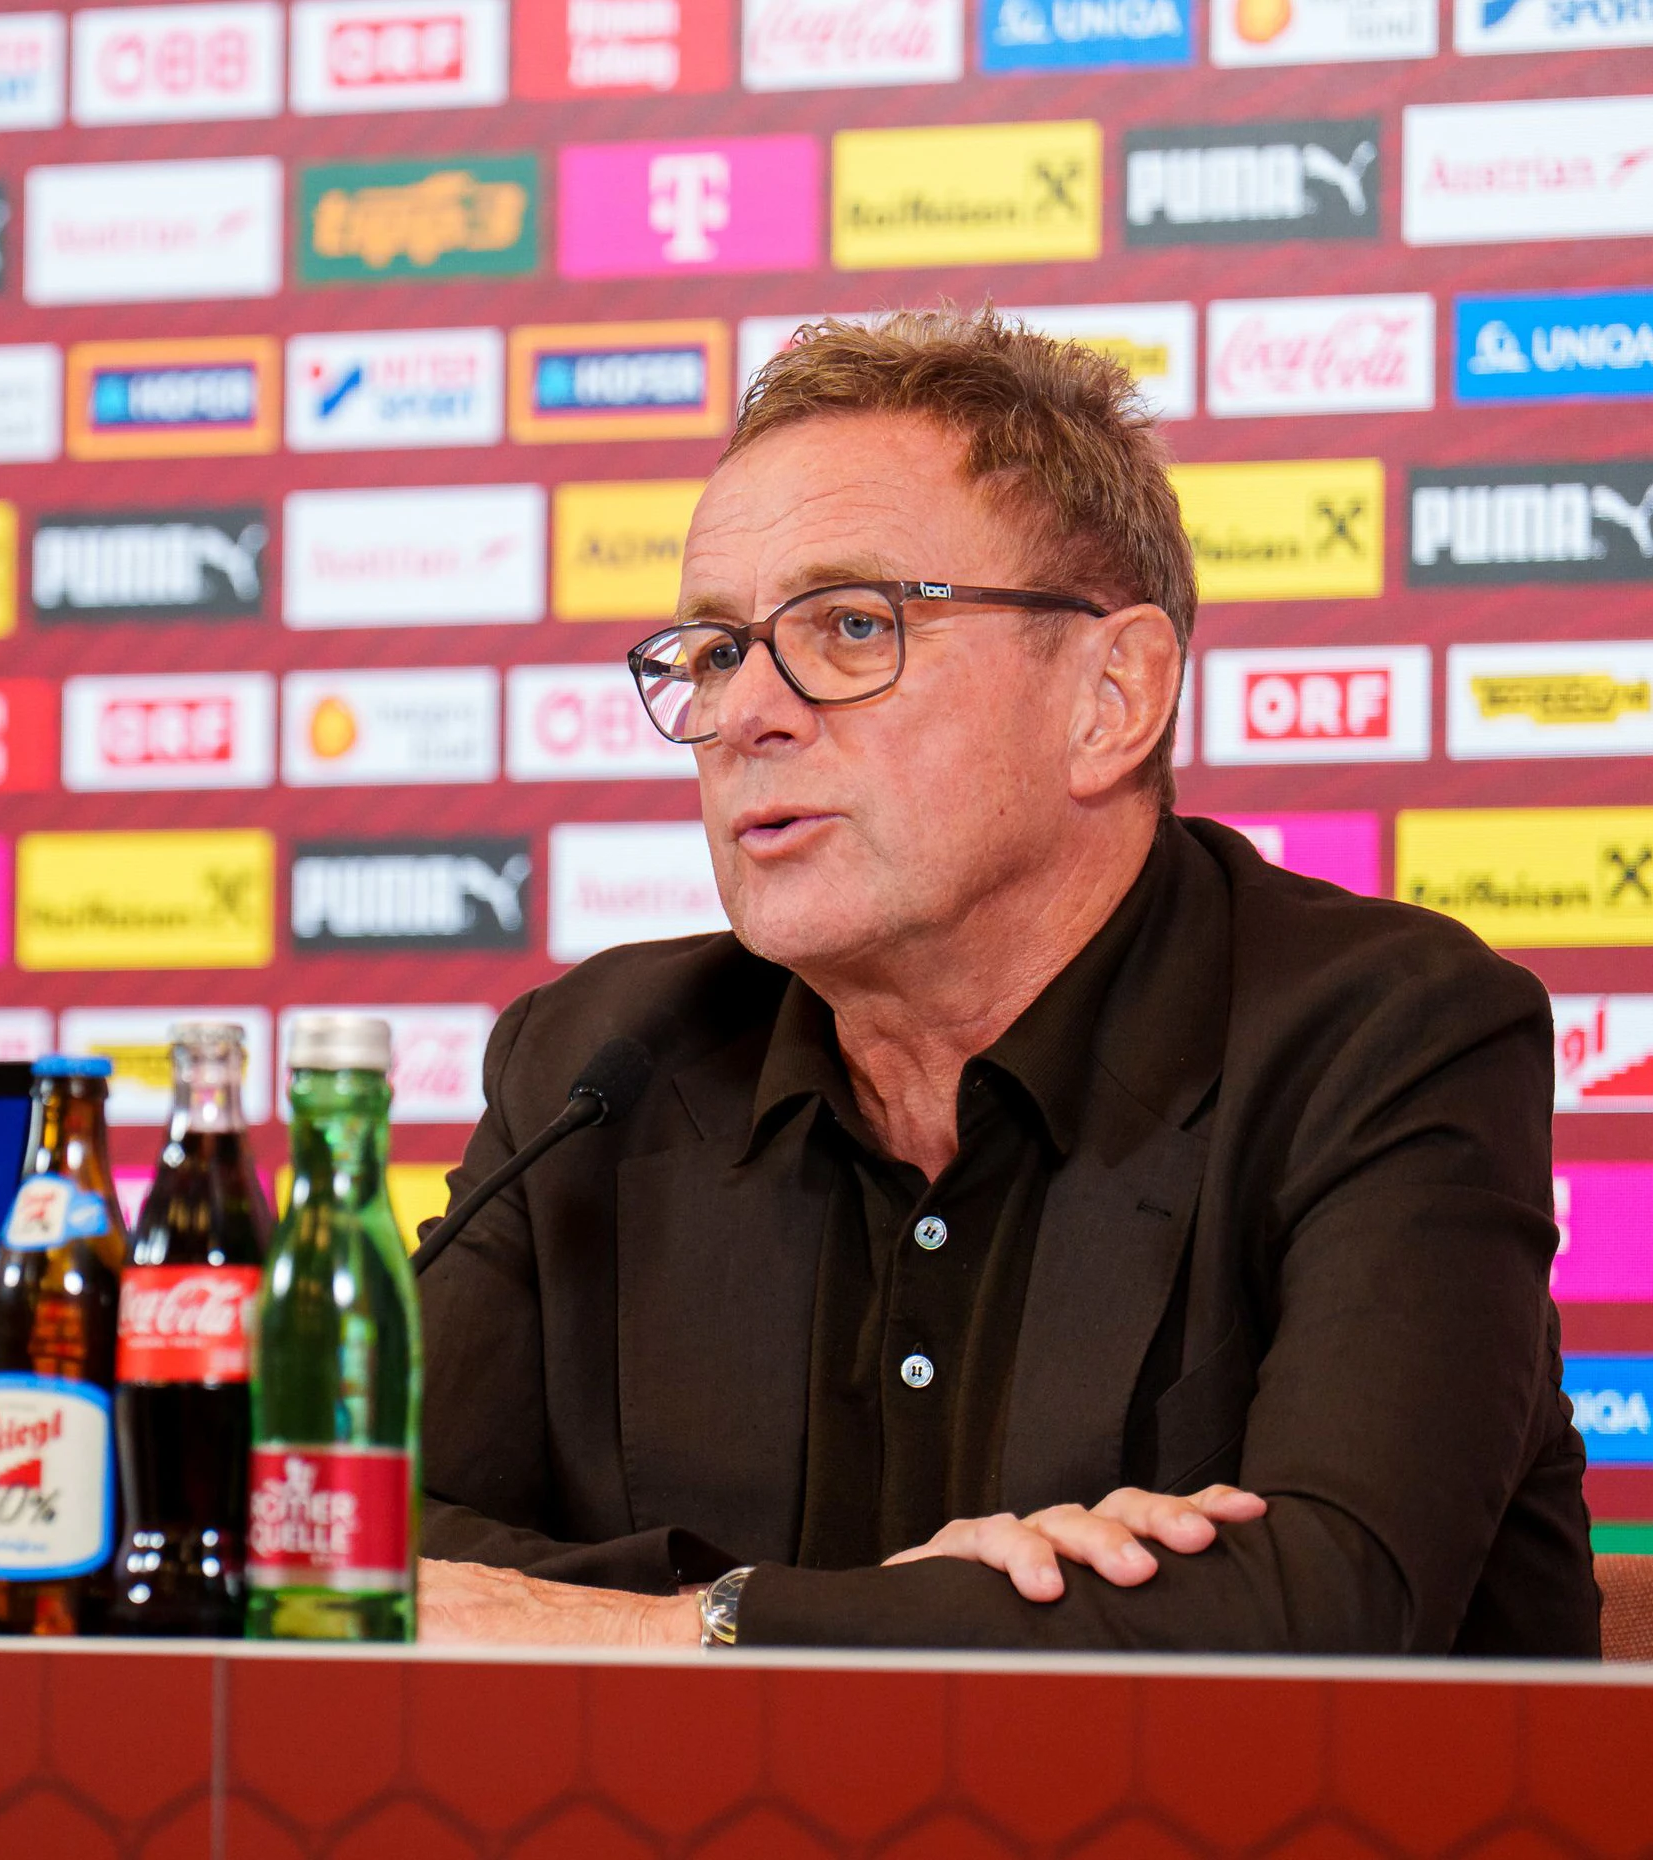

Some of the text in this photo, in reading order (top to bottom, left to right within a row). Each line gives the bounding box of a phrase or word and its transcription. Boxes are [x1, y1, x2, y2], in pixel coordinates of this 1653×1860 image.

[1126, 144, 1307, 226] PUMA
[33, 523, 205, 610] PUMA
[1410, 482, 1595, 568] PUMA
[1247, 672, 1389, 739] ORF
[292, 854, 469, 940] PUMA
